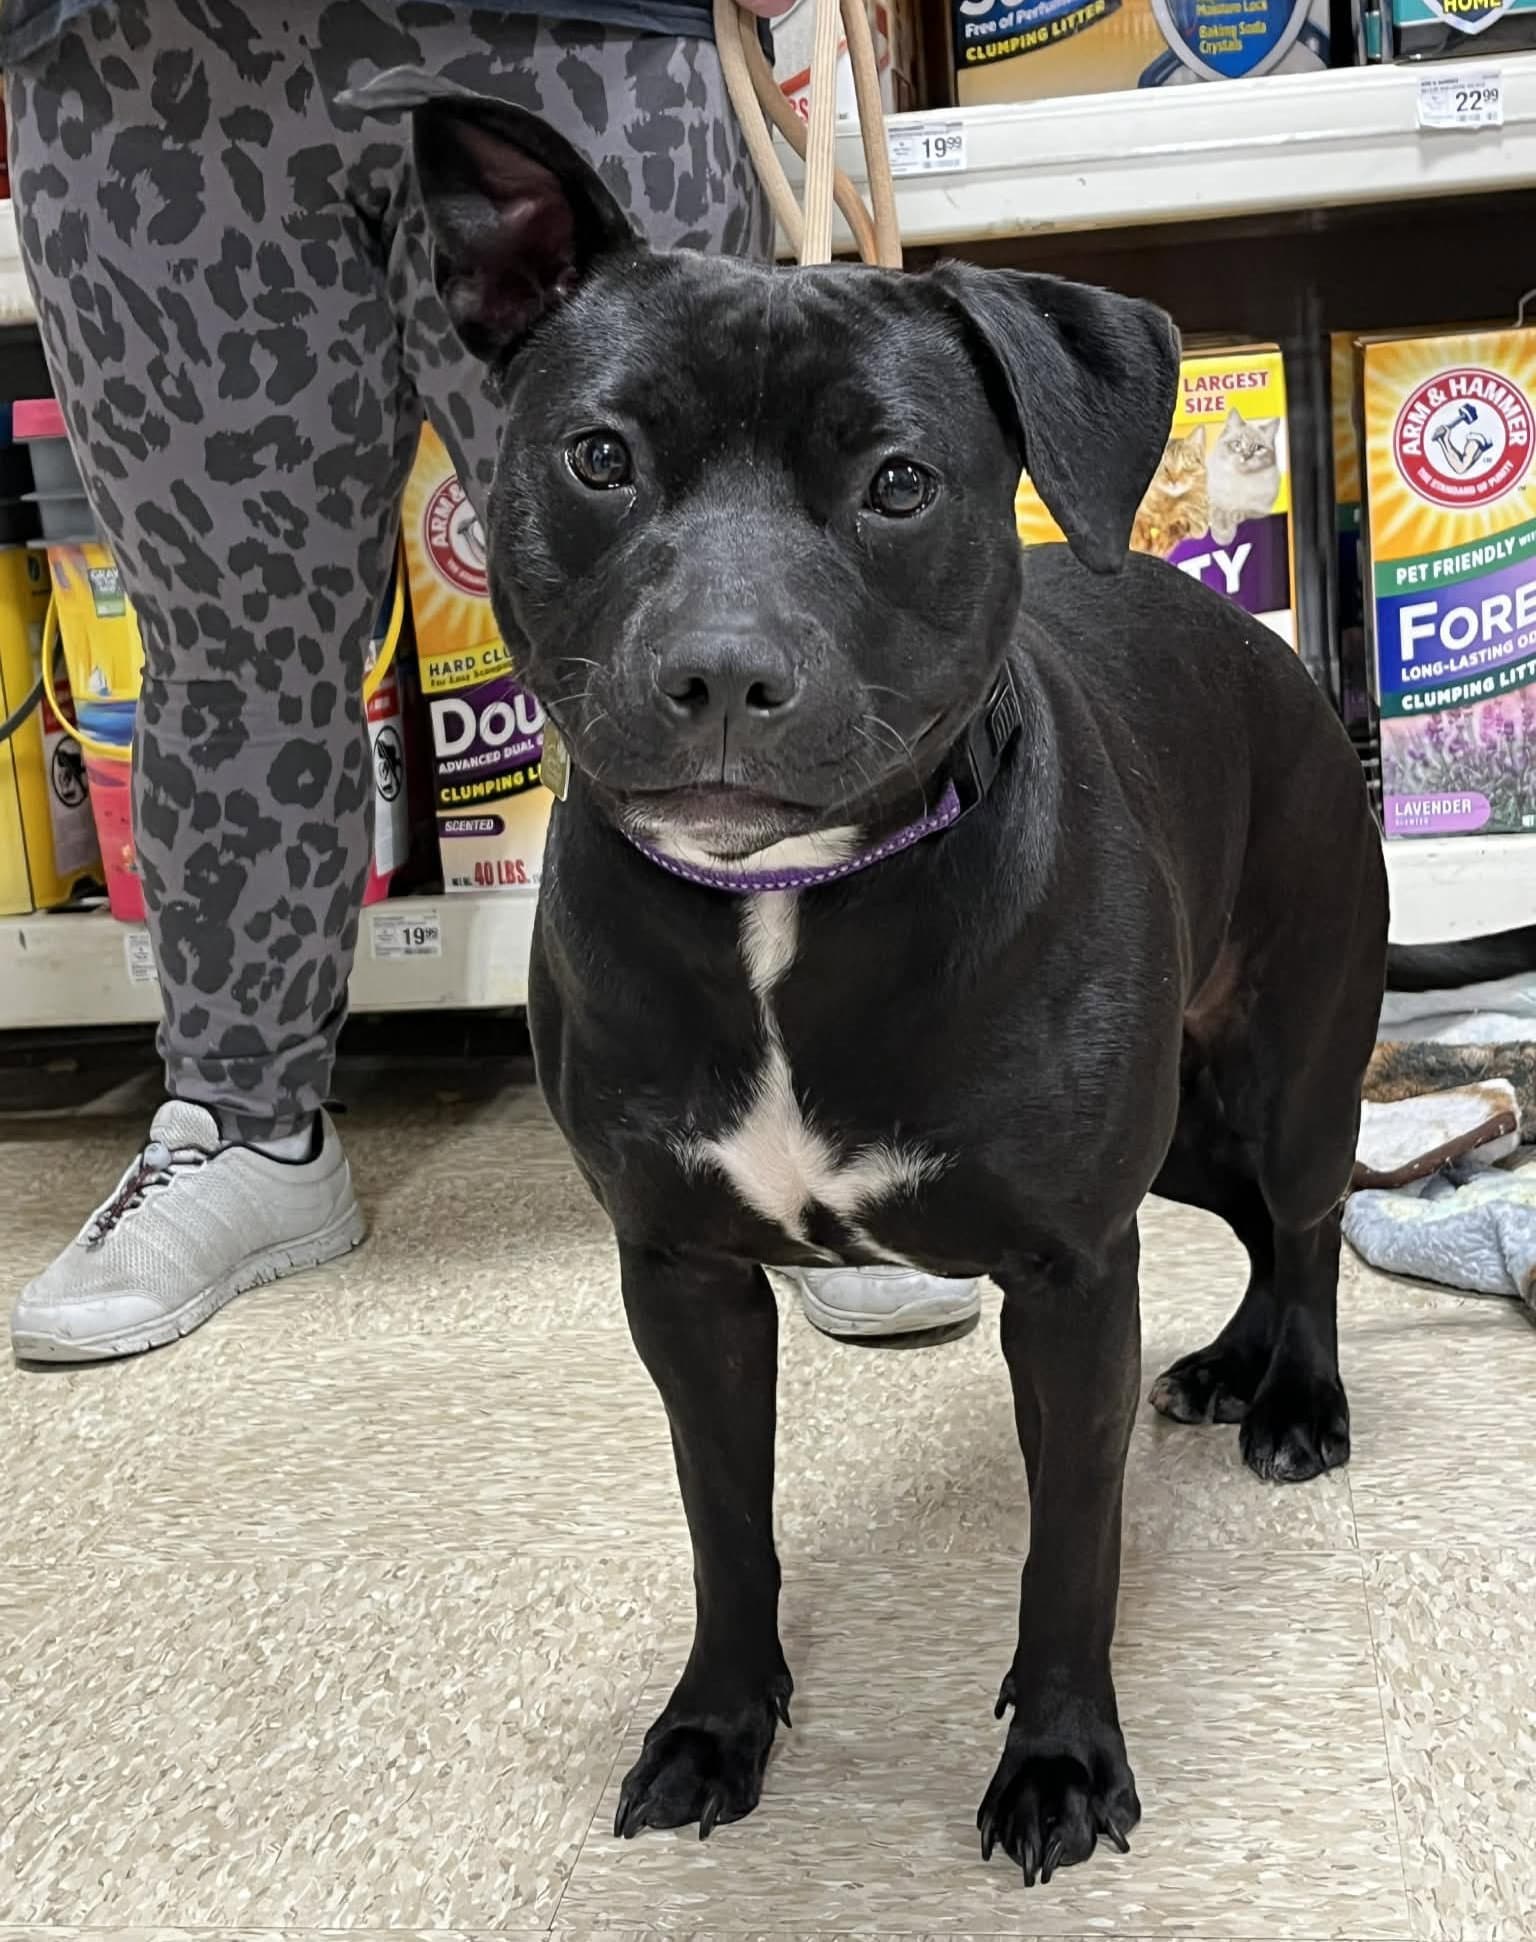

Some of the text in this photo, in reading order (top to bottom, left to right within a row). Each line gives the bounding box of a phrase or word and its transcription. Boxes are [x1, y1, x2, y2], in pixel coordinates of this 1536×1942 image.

[1443, 0, 1502, 13] HOME
[965, 20, 997, 39] Free
[999, 12, 1014, 29] of
[965, 27, 1049, 61] CLUMPING
[1051, 1, 1106, 36] LITTER
[1183, 371, 1269, 393] LARGEST
[1184, 395, 1225, 414] SIZE
[1402, 376, 1528, 456] ARM & HAMMER
[431, 496, 456, 547] ARM
[1396, 562, 1429, 586] PET
[1432, 536, 1516, 579] FRIENDLY
[429, 656, 476, 677] HARD
[1401, 640, 1514, 683] LONG-LASTING
[1401, 676, 1495, 711] CLUMPING
[438, 750, 501, 775] ADVANCED
[503, 739, 535, 759] DUAL
[440, 770, 525, 802] CLUMPING
[1394, 798, 1472, 816] LAVENDER
[445, 819, 494, 832] SCENTED
[474, 861, 495, 886] 40
